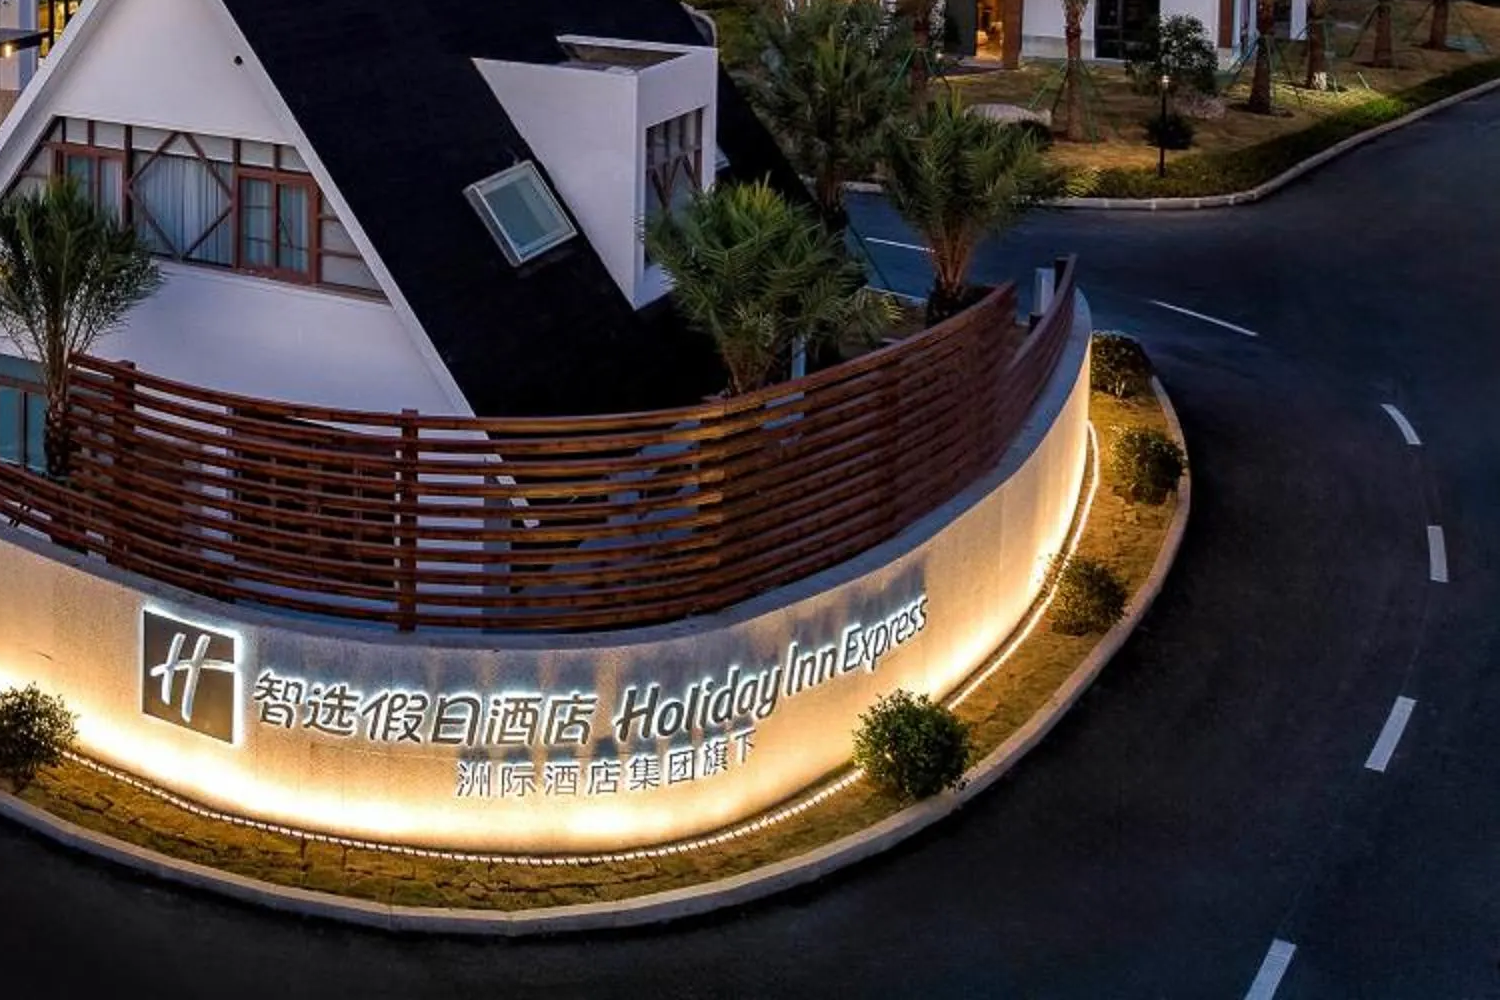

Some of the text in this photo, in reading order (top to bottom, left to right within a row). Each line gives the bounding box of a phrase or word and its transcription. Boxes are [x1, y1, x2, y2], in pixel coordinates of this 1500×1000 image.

[253, 669, 598, 747] 智选假日酒店
[613, 596, 928, 742] Holiday Inn Express
[456, 728, 757, 799] 洲际酒店集团旗下
